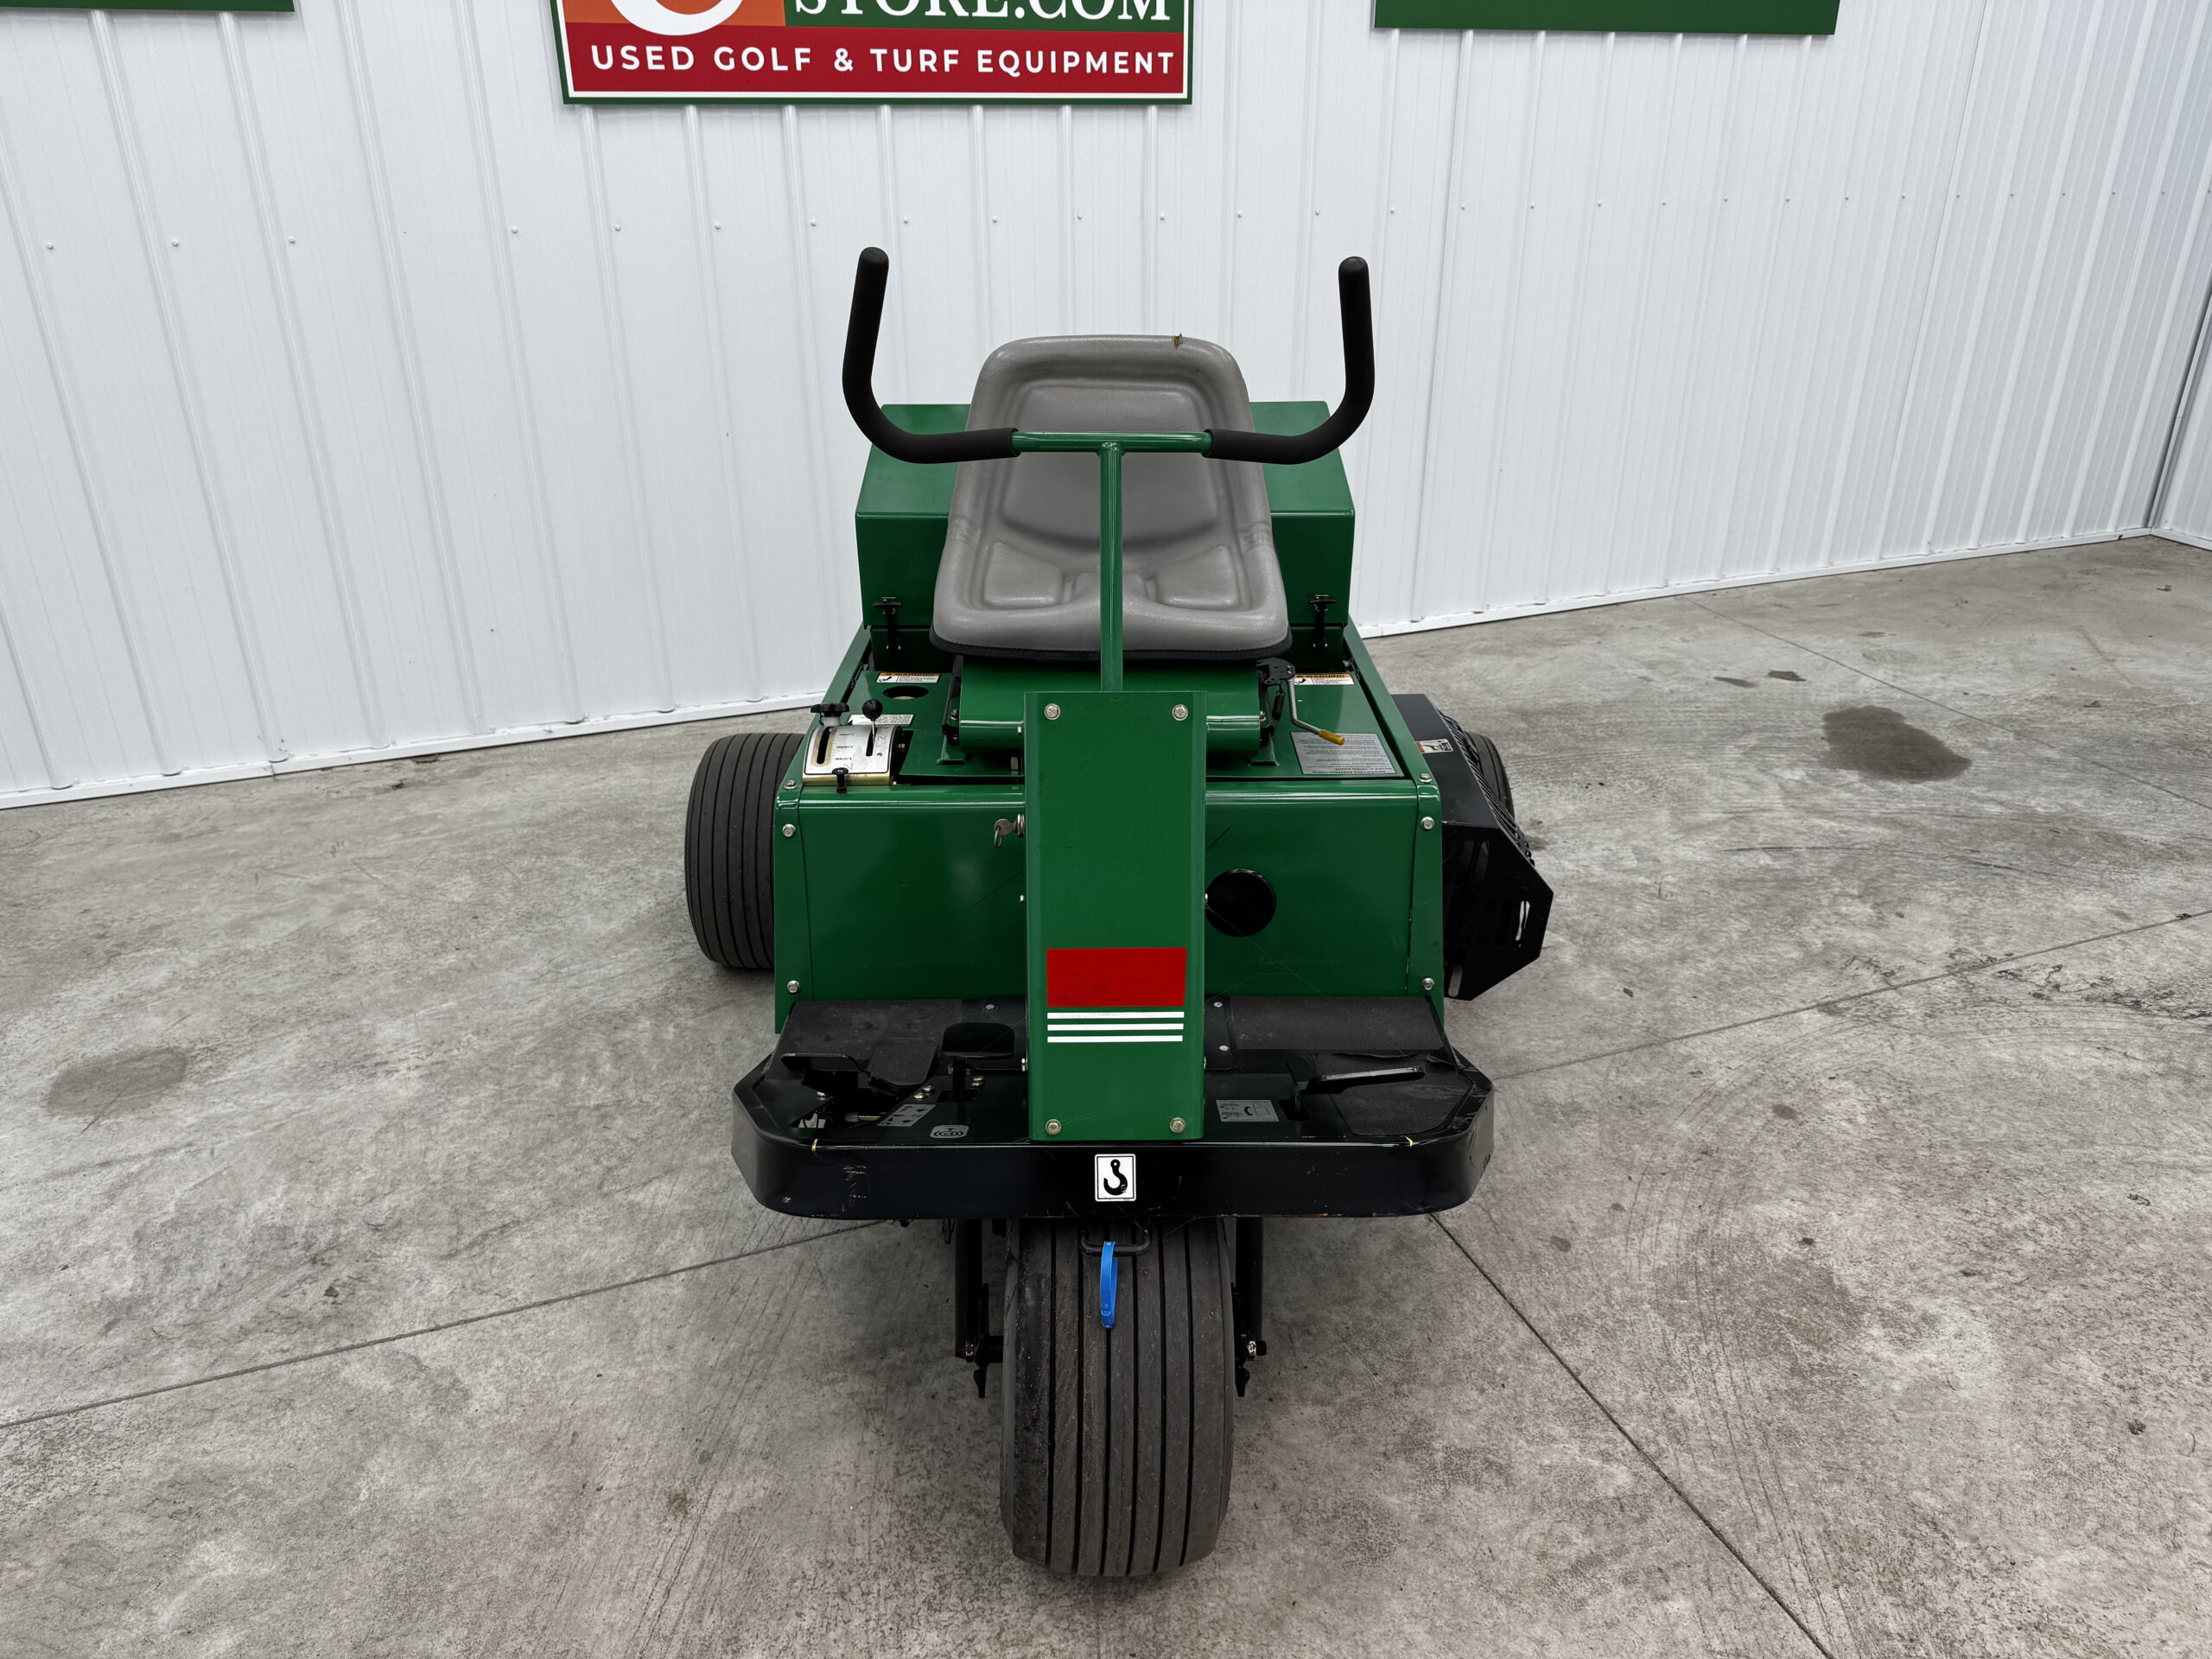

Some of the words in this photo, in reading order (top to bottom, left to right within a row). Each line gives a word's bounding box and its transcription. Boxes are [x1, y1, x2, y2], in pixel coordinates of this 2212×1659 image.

[591, 45, 694, 70] USED
[715, 47, 810, 71] GOLF
[834, 48, 854, 72] &
[869, 48, 958, 73] TURF
[977, 49, 1174, 77] EQUIPMENT
